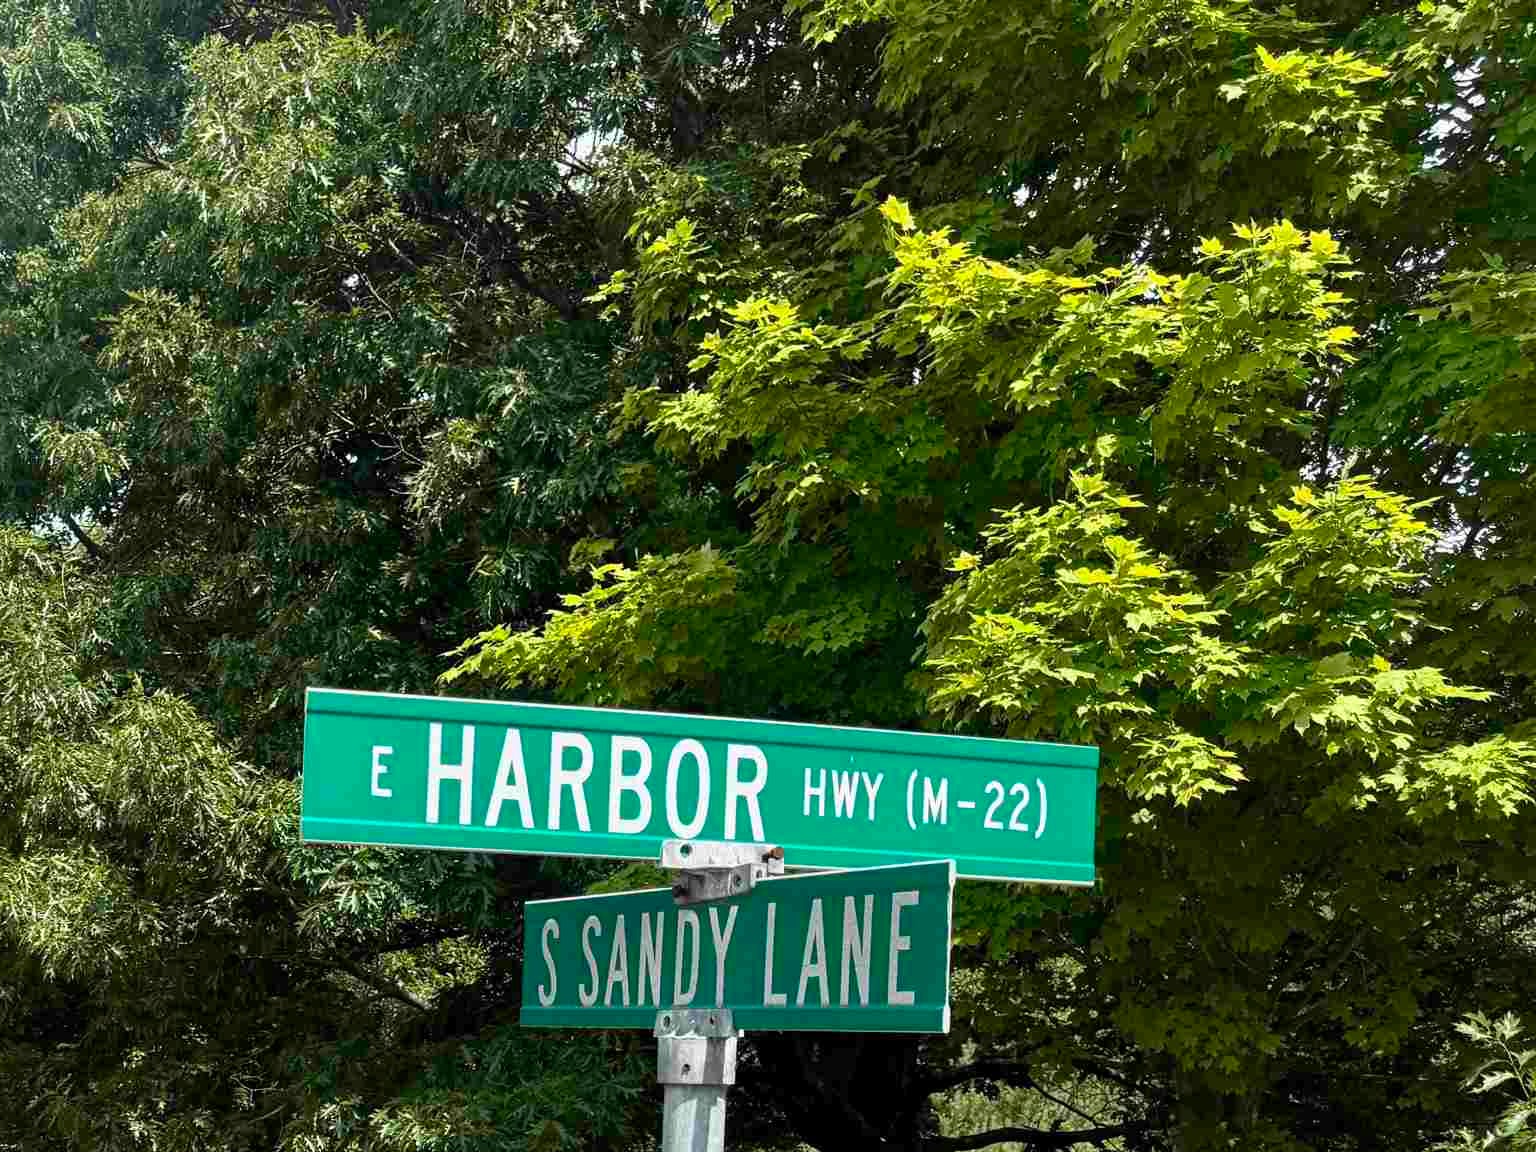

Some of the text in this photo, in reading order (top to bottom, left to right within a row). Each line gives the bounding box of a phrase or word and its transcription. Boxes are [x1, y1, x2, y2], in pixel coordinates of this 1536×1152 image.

[371, 723, 1048, 842] E HARBOR HWY (M-22)
[538, 890, 920, 1008] S SANDY LANE
